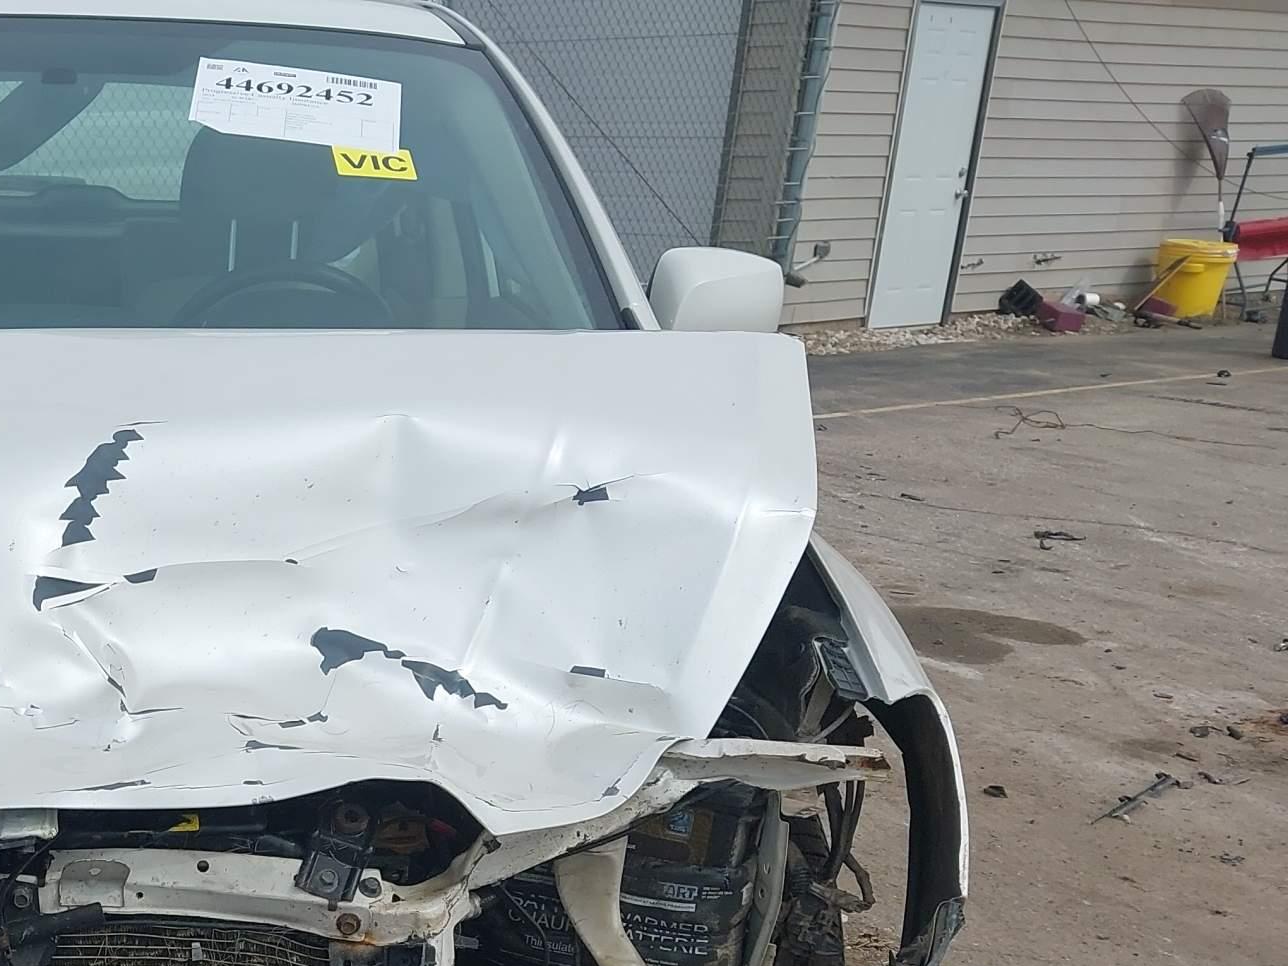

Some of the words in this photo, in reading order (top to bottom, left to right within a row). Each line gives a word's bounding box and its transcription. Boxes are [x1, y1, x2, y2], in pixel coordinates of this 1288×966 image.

[215, 77, 373, 106] 44692452
[340, 153, 409, 172] VIC
[625, 928, 710, 956] ATTERIE
